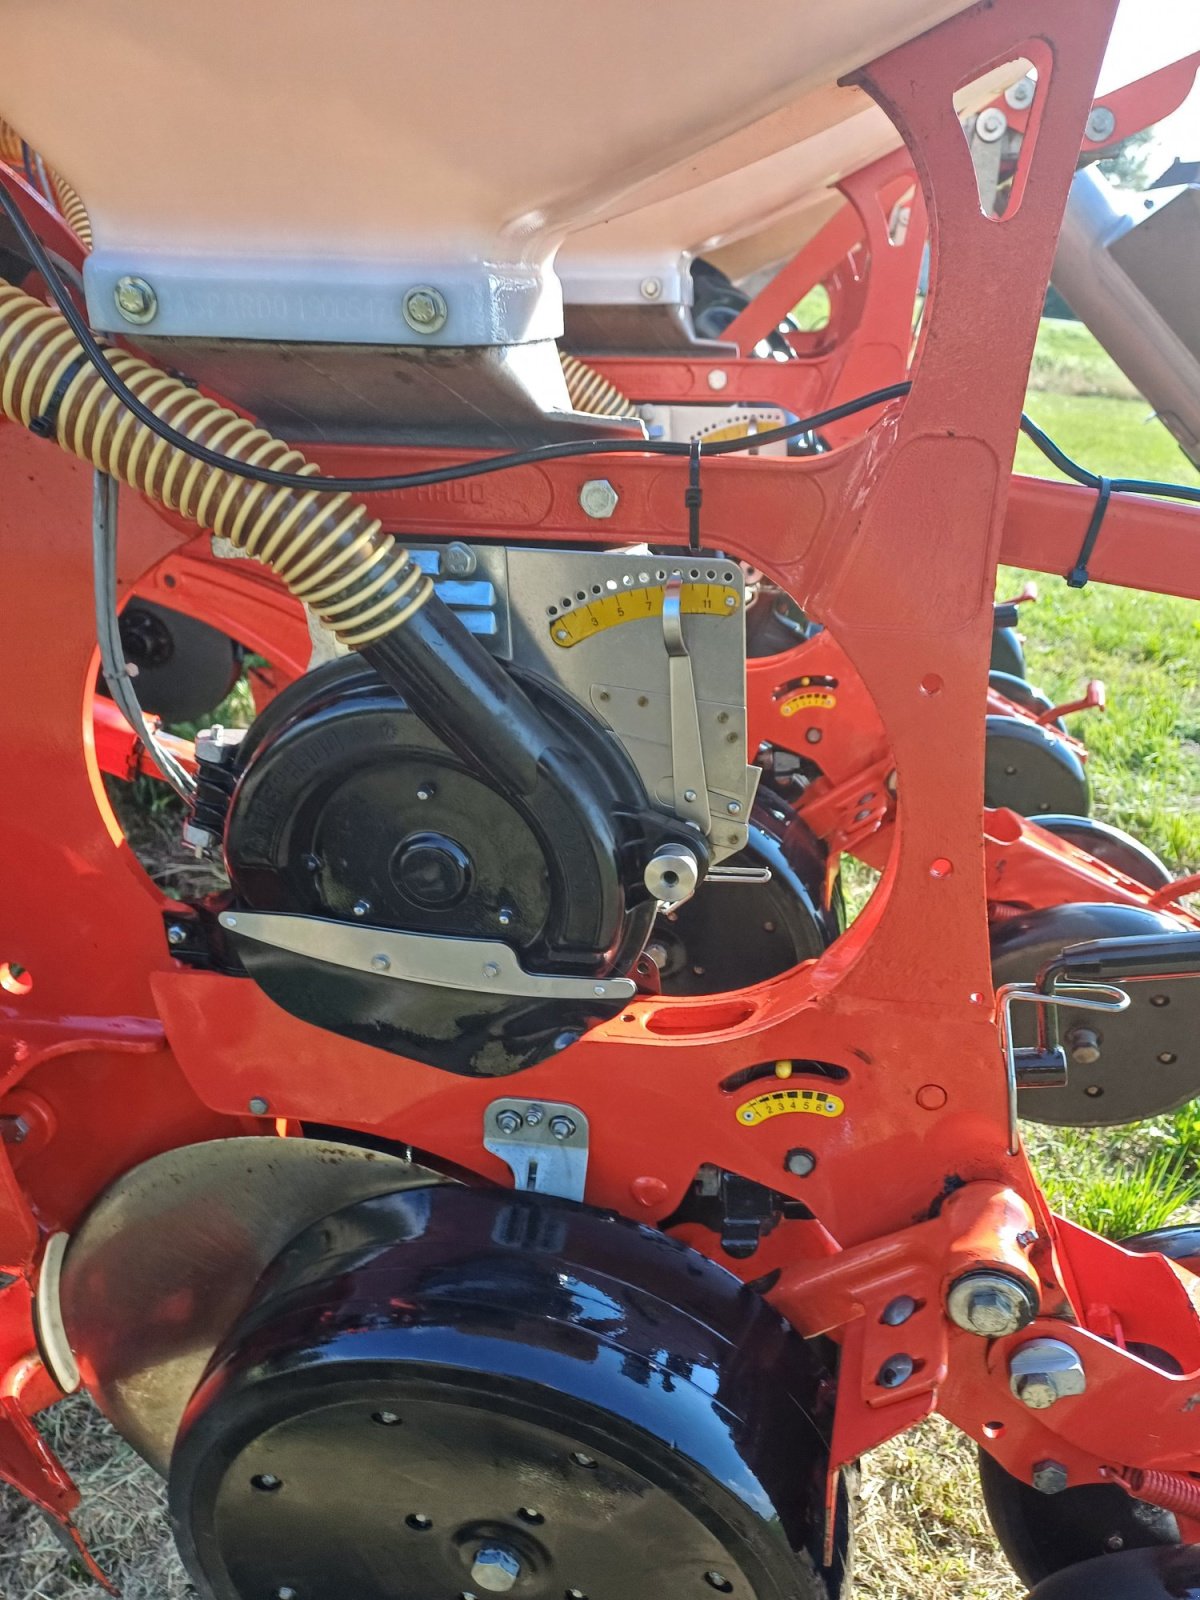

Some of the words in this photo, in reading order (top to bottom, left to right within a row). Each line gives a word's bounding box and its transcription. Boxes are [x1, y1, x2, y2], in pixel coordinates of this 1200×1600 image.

[591, 617, 599, 626] 3
[617, 607, 625, 617] 5
[645, 601, 652, 611] 7
[703, 600, 712, 609] 11
[766, 1105, 774, 1114] 2
[778, 1102, 785, 1111] 3
[790, 1101, 797, 1109] 4
[802, 1101, 810, 1110] 5
[815, 1103, 822, 1112] 6
